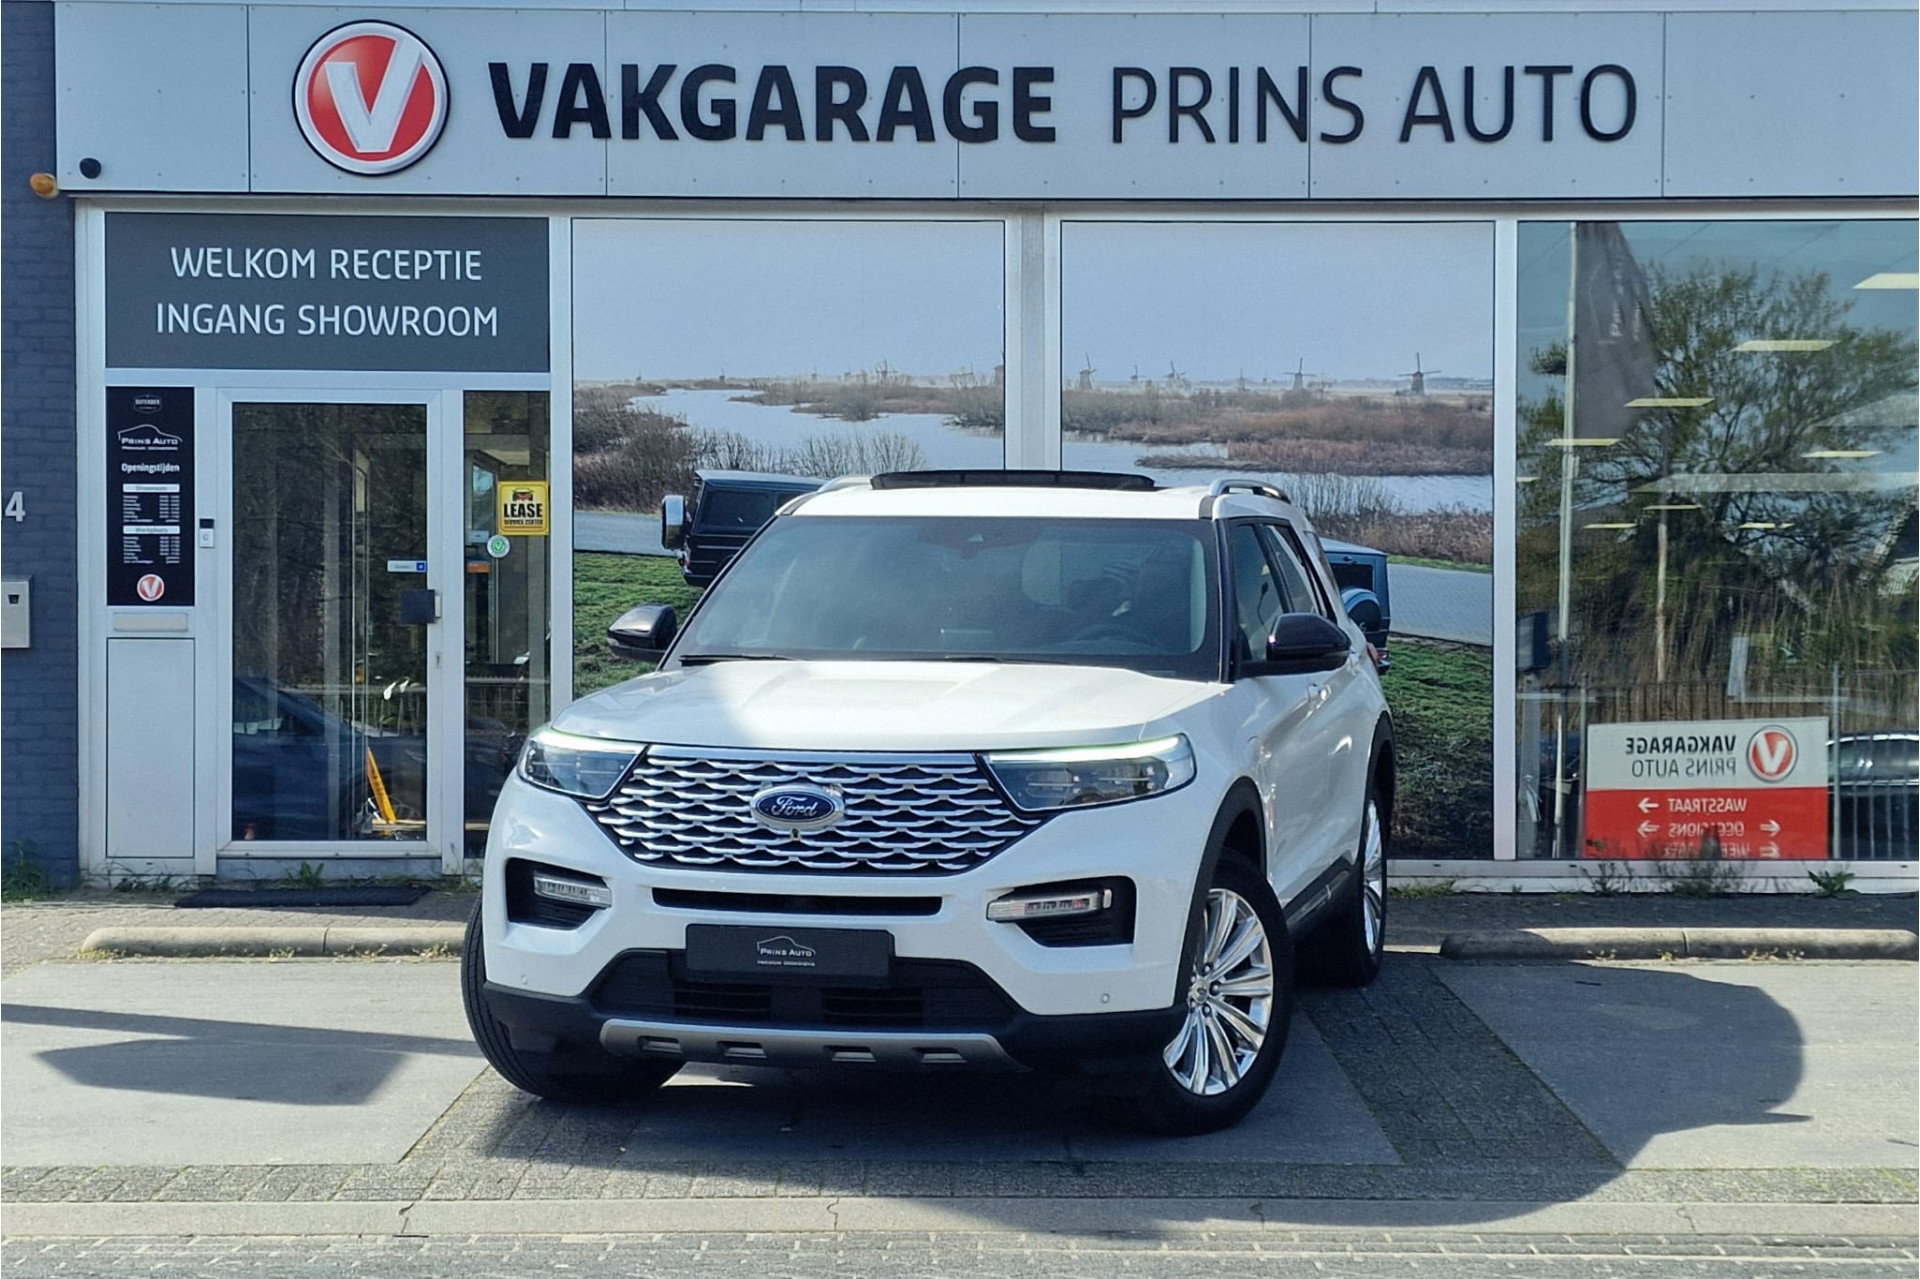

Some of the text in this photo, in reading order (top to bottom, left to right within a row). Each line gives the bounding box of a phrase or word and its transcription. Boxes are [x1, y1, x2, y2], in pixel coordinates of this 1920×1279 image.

[488, 62, 1637, 144] VAKGARAGE PRINS AUTO
[170, 246, 482, 280] WELKOM RECEPTIE
[156, 303, 498, 337] INGANG SHOWROOM
[121, 462, 180, 474] Openingstijden
[4, 491, 26, 522] 4
[503, 503, 543, 518] LEASE
[771, 796, 819, 816] Ford
[760, 948, 812, 957] PRINS AUTO
